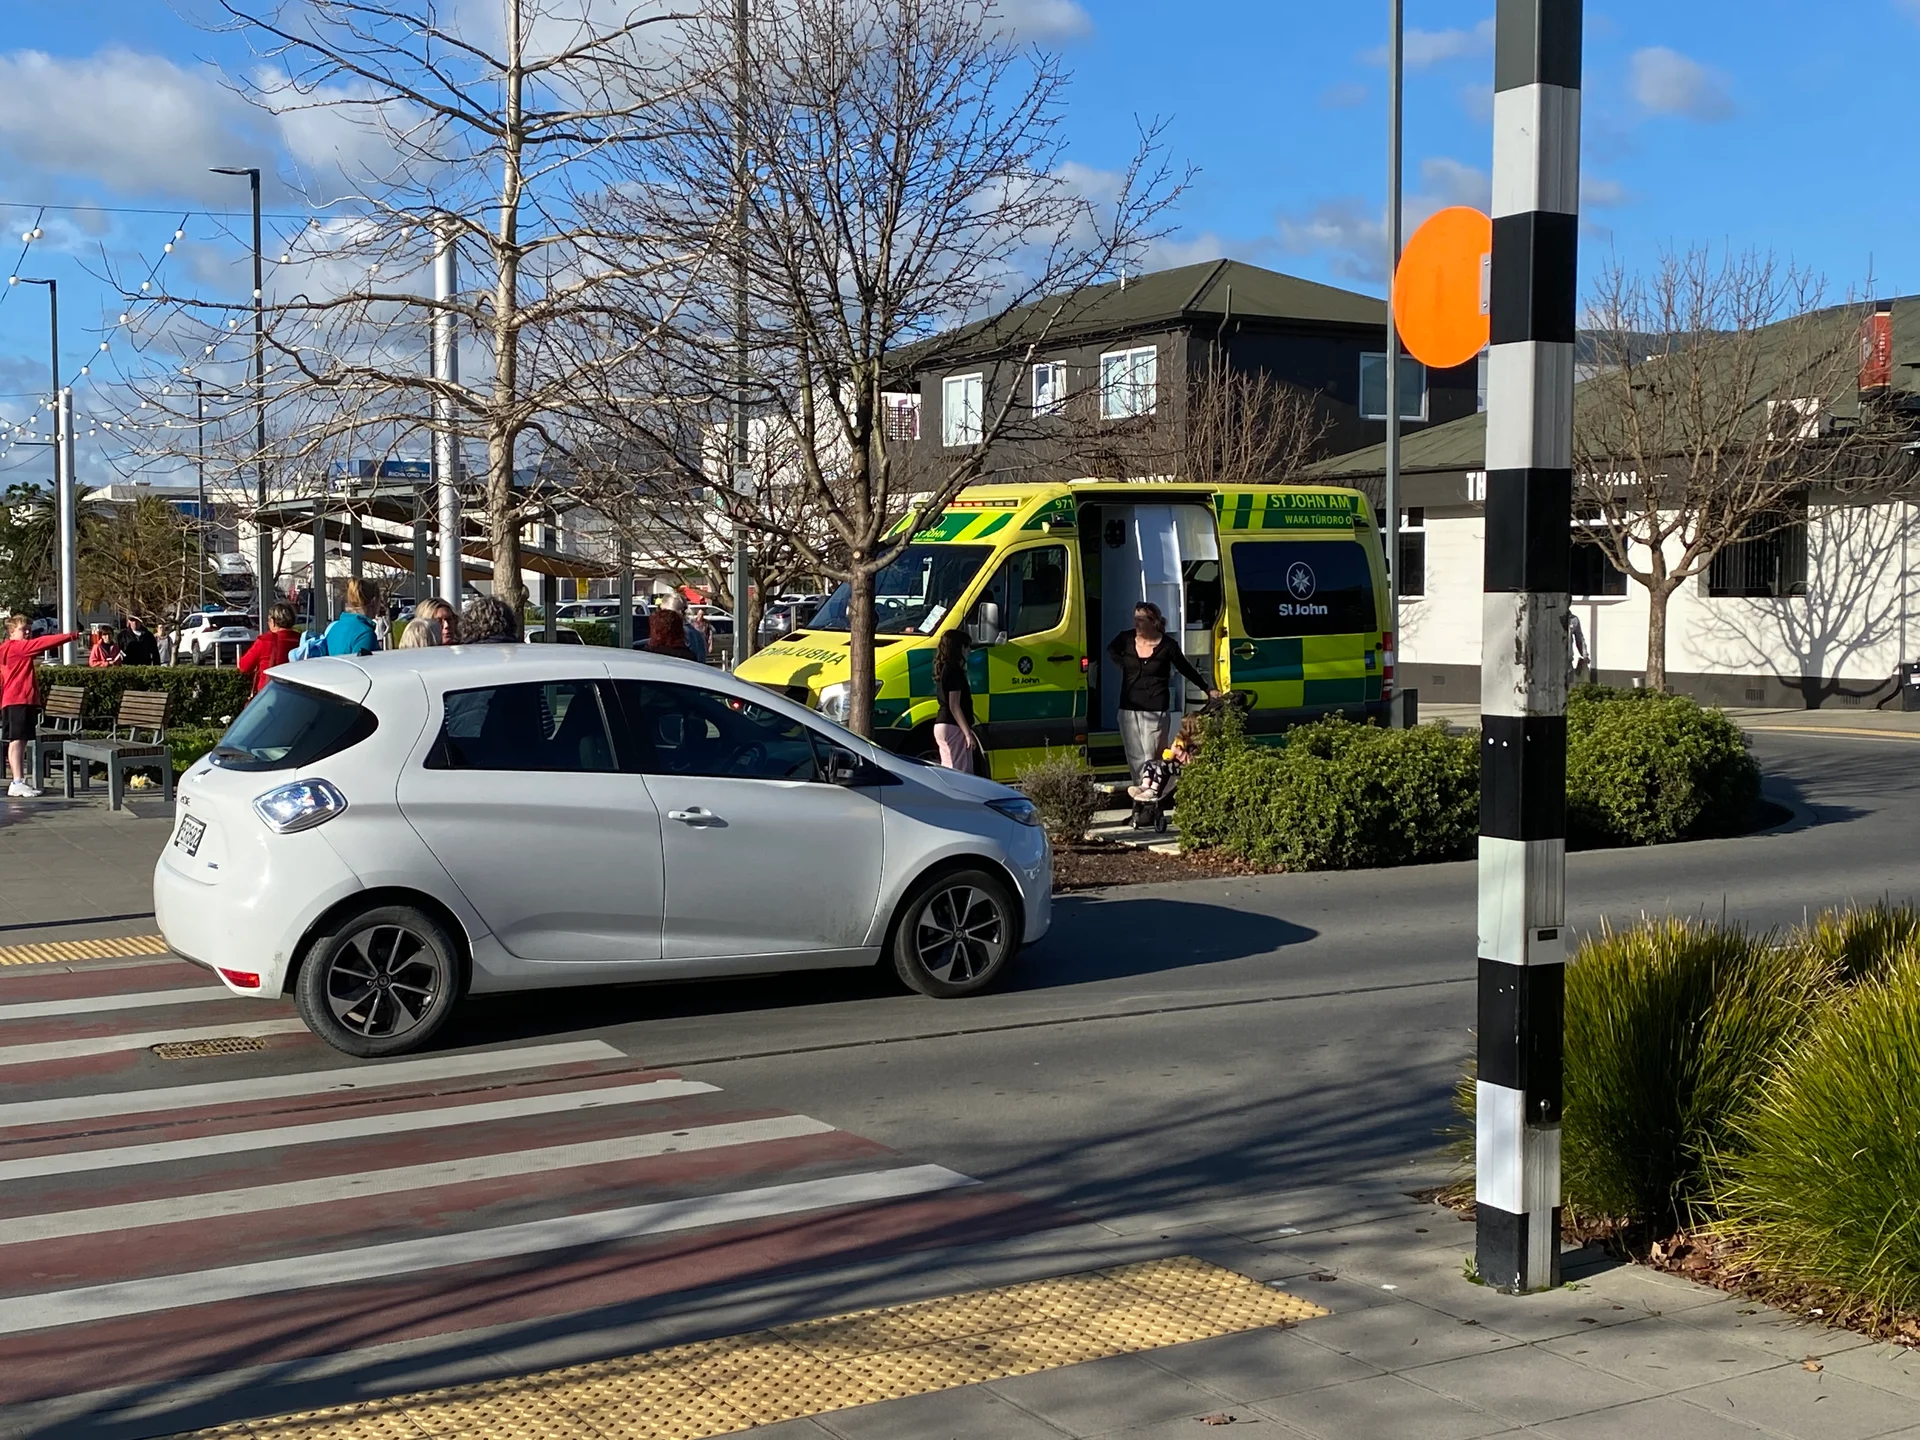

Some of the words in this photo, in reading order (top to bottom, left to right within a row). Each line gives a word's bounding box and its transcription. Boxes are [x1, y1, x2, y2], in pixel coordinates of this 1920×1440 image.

[1466, 471, 1487, 501] TH
[1055, 499, 1074, 509] 971
[1271, 494, 1286, 508] ST
[1291, 494, 1326, 508] JOHN
[1329, 494, 1350, 508] AM
[1285, 515, 1309, 525] WAKA
[1311, 514, 1343, 525] TŪRORO
[1278, 603, 1293, 617] St
[1295, 602, 1328, 616] John
[1011, 677, 1020, 685] St
